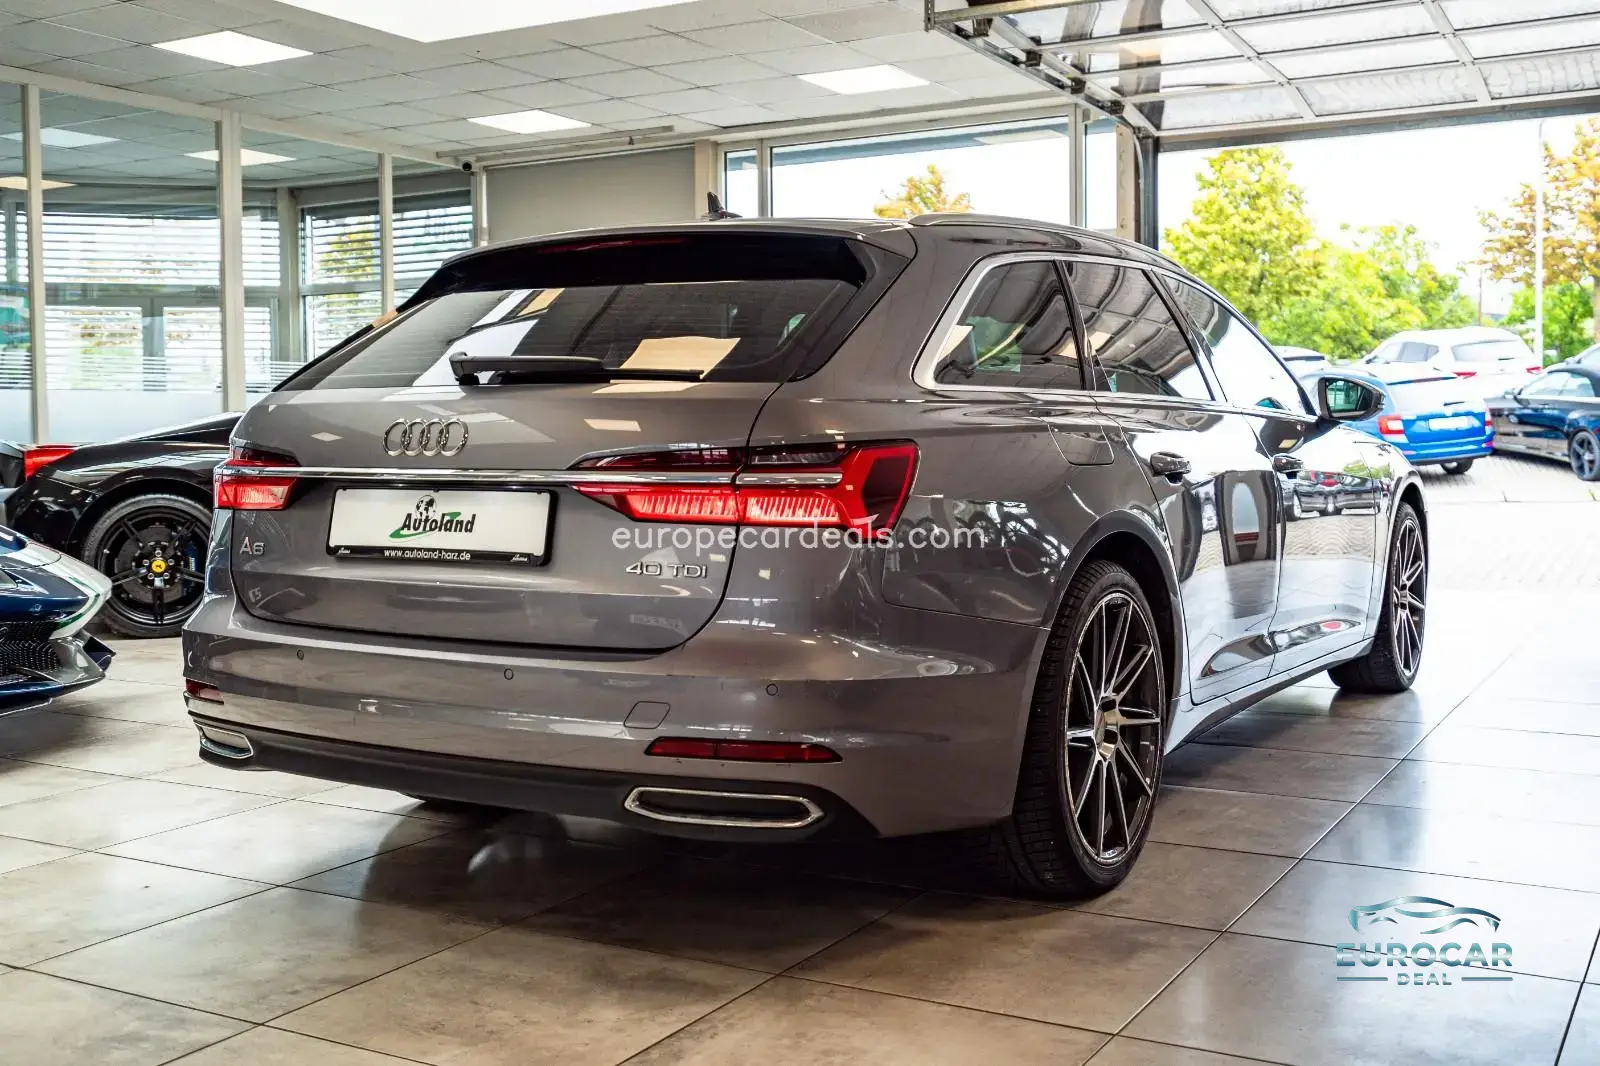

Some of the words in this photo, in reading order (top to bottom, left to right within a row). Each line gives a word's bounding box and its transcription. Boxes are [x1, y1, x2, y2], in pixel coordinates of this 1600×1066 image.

[400, 512, 476, 533] Autoland
[239, 536, 265, 556] A6
[384, 548, 471, 561] www.autoland-harz.de
[625, 561, 661, 577] 40
[667, 563, 708, 578] TDI
